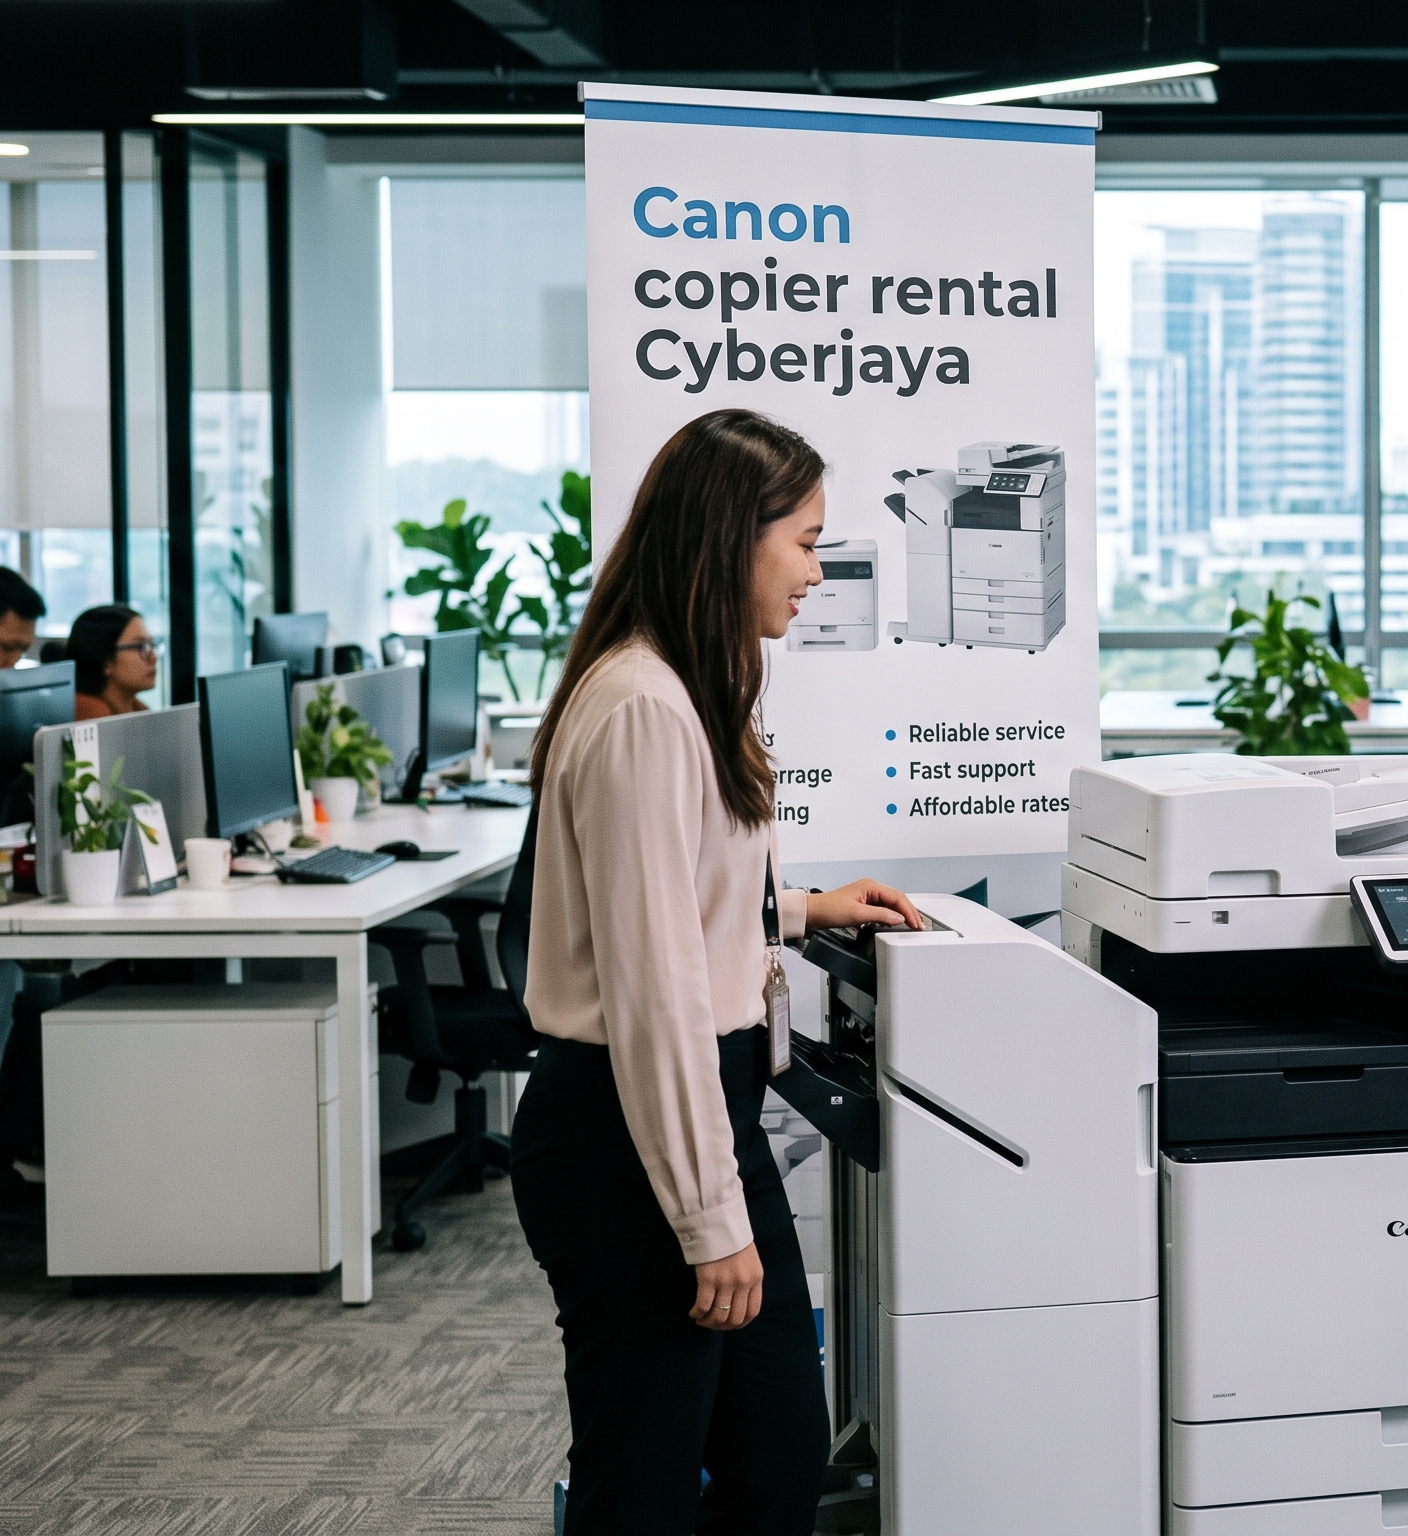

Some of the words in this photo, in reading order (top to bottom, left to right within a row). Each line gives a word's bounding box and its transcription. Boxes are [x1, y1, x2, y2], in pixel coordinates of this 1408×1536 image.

[634, 187, 849, 243] Canon
[635, 257, 848, 323] copier
[872, 268, 1056, 318] rental
[636, 328, 969, 397] Cyberjaya
[910, 722, 989, 742] Reliable
[996, 720, 1065, 740] service
[911, 762, 951, 779] Fast
[958, 760, 1035, 782] support
[777, 801, 809, 825] ing
[910, 795, 1015, 816] Affordable
[1023, 796, 1069, 812] rates
